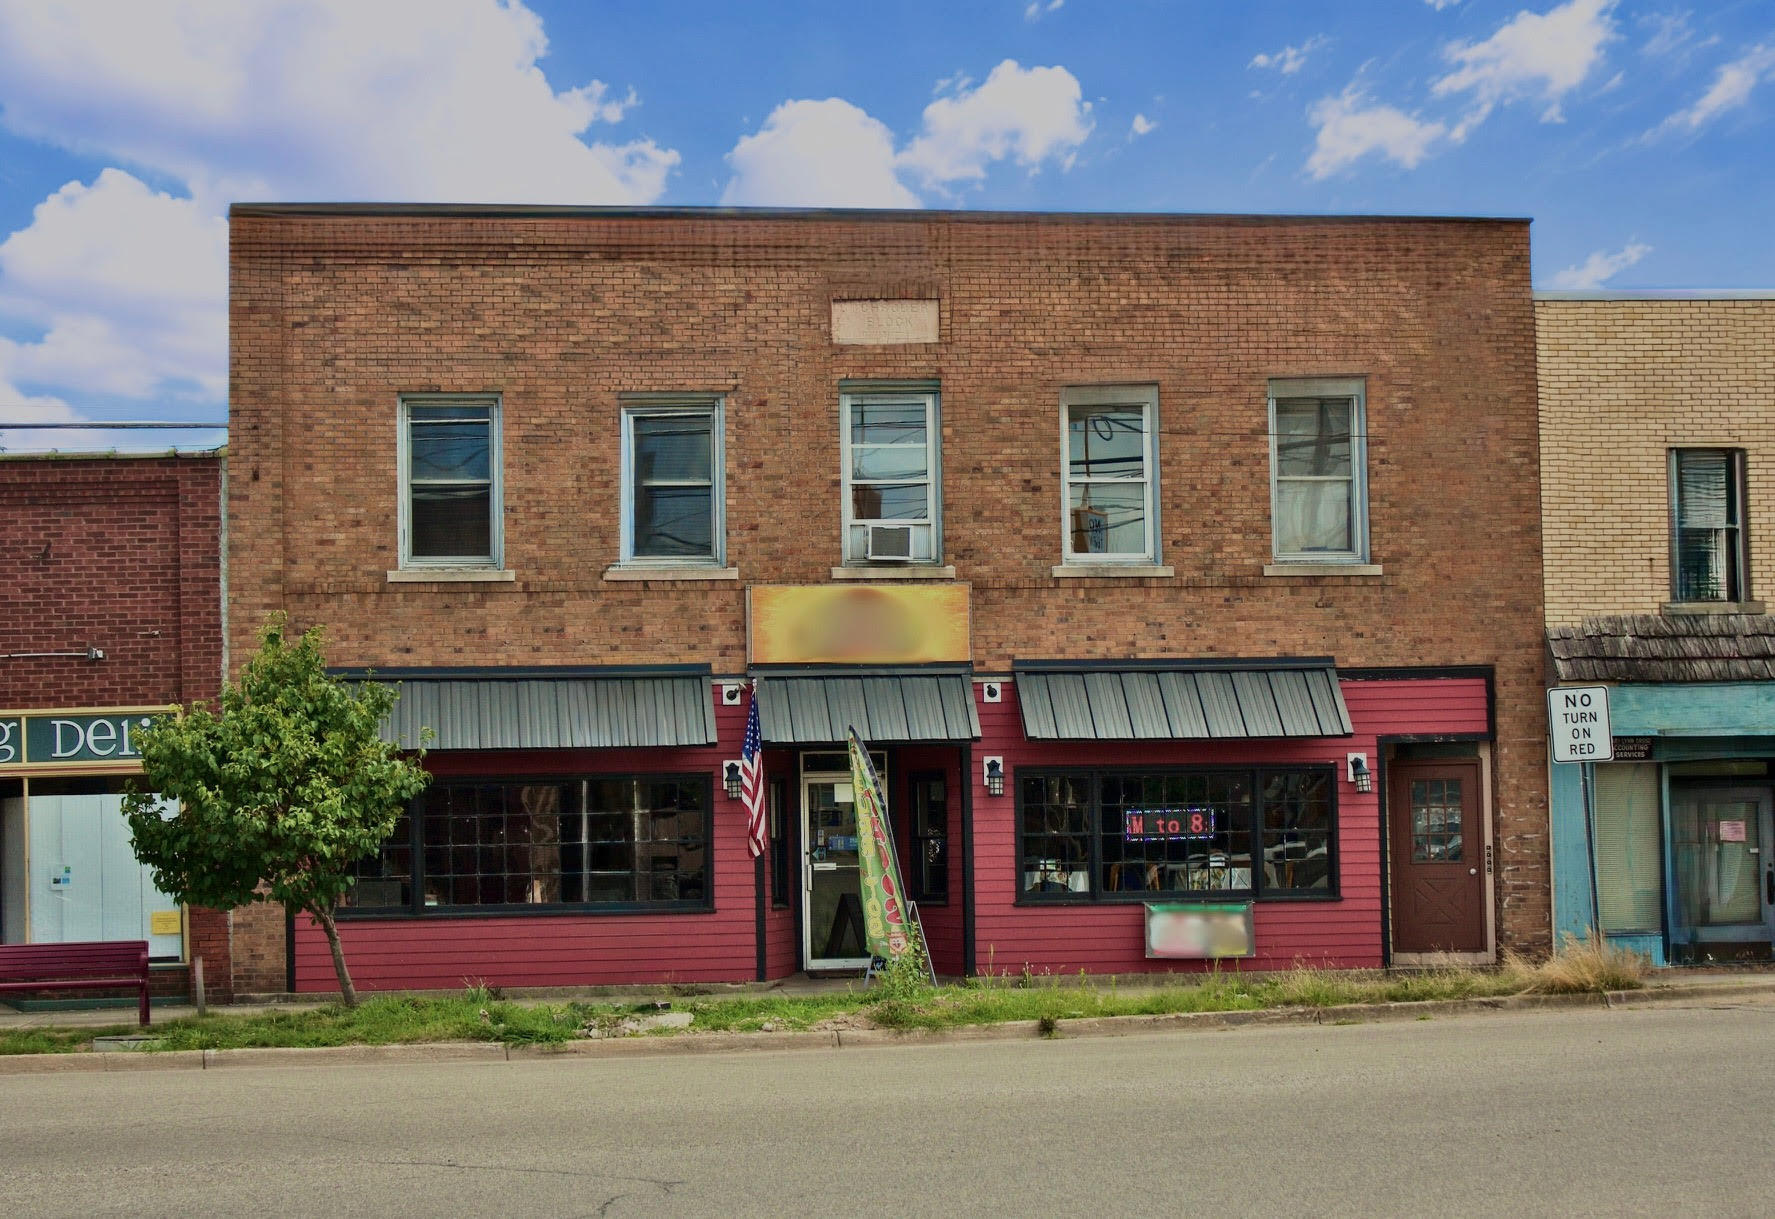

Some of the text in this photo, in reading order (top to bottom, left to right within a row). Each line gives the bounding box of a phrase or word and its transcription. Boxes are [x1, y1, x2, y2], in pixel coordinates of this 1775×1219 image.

[1565, 694, 1592, 708] NO
[1563, 711, 1597, 724] TURN
[1571, 727, 1591, 740] ON
[1569, 743, 1595, 755] RED
[1156, 819, 1181, 834] to
